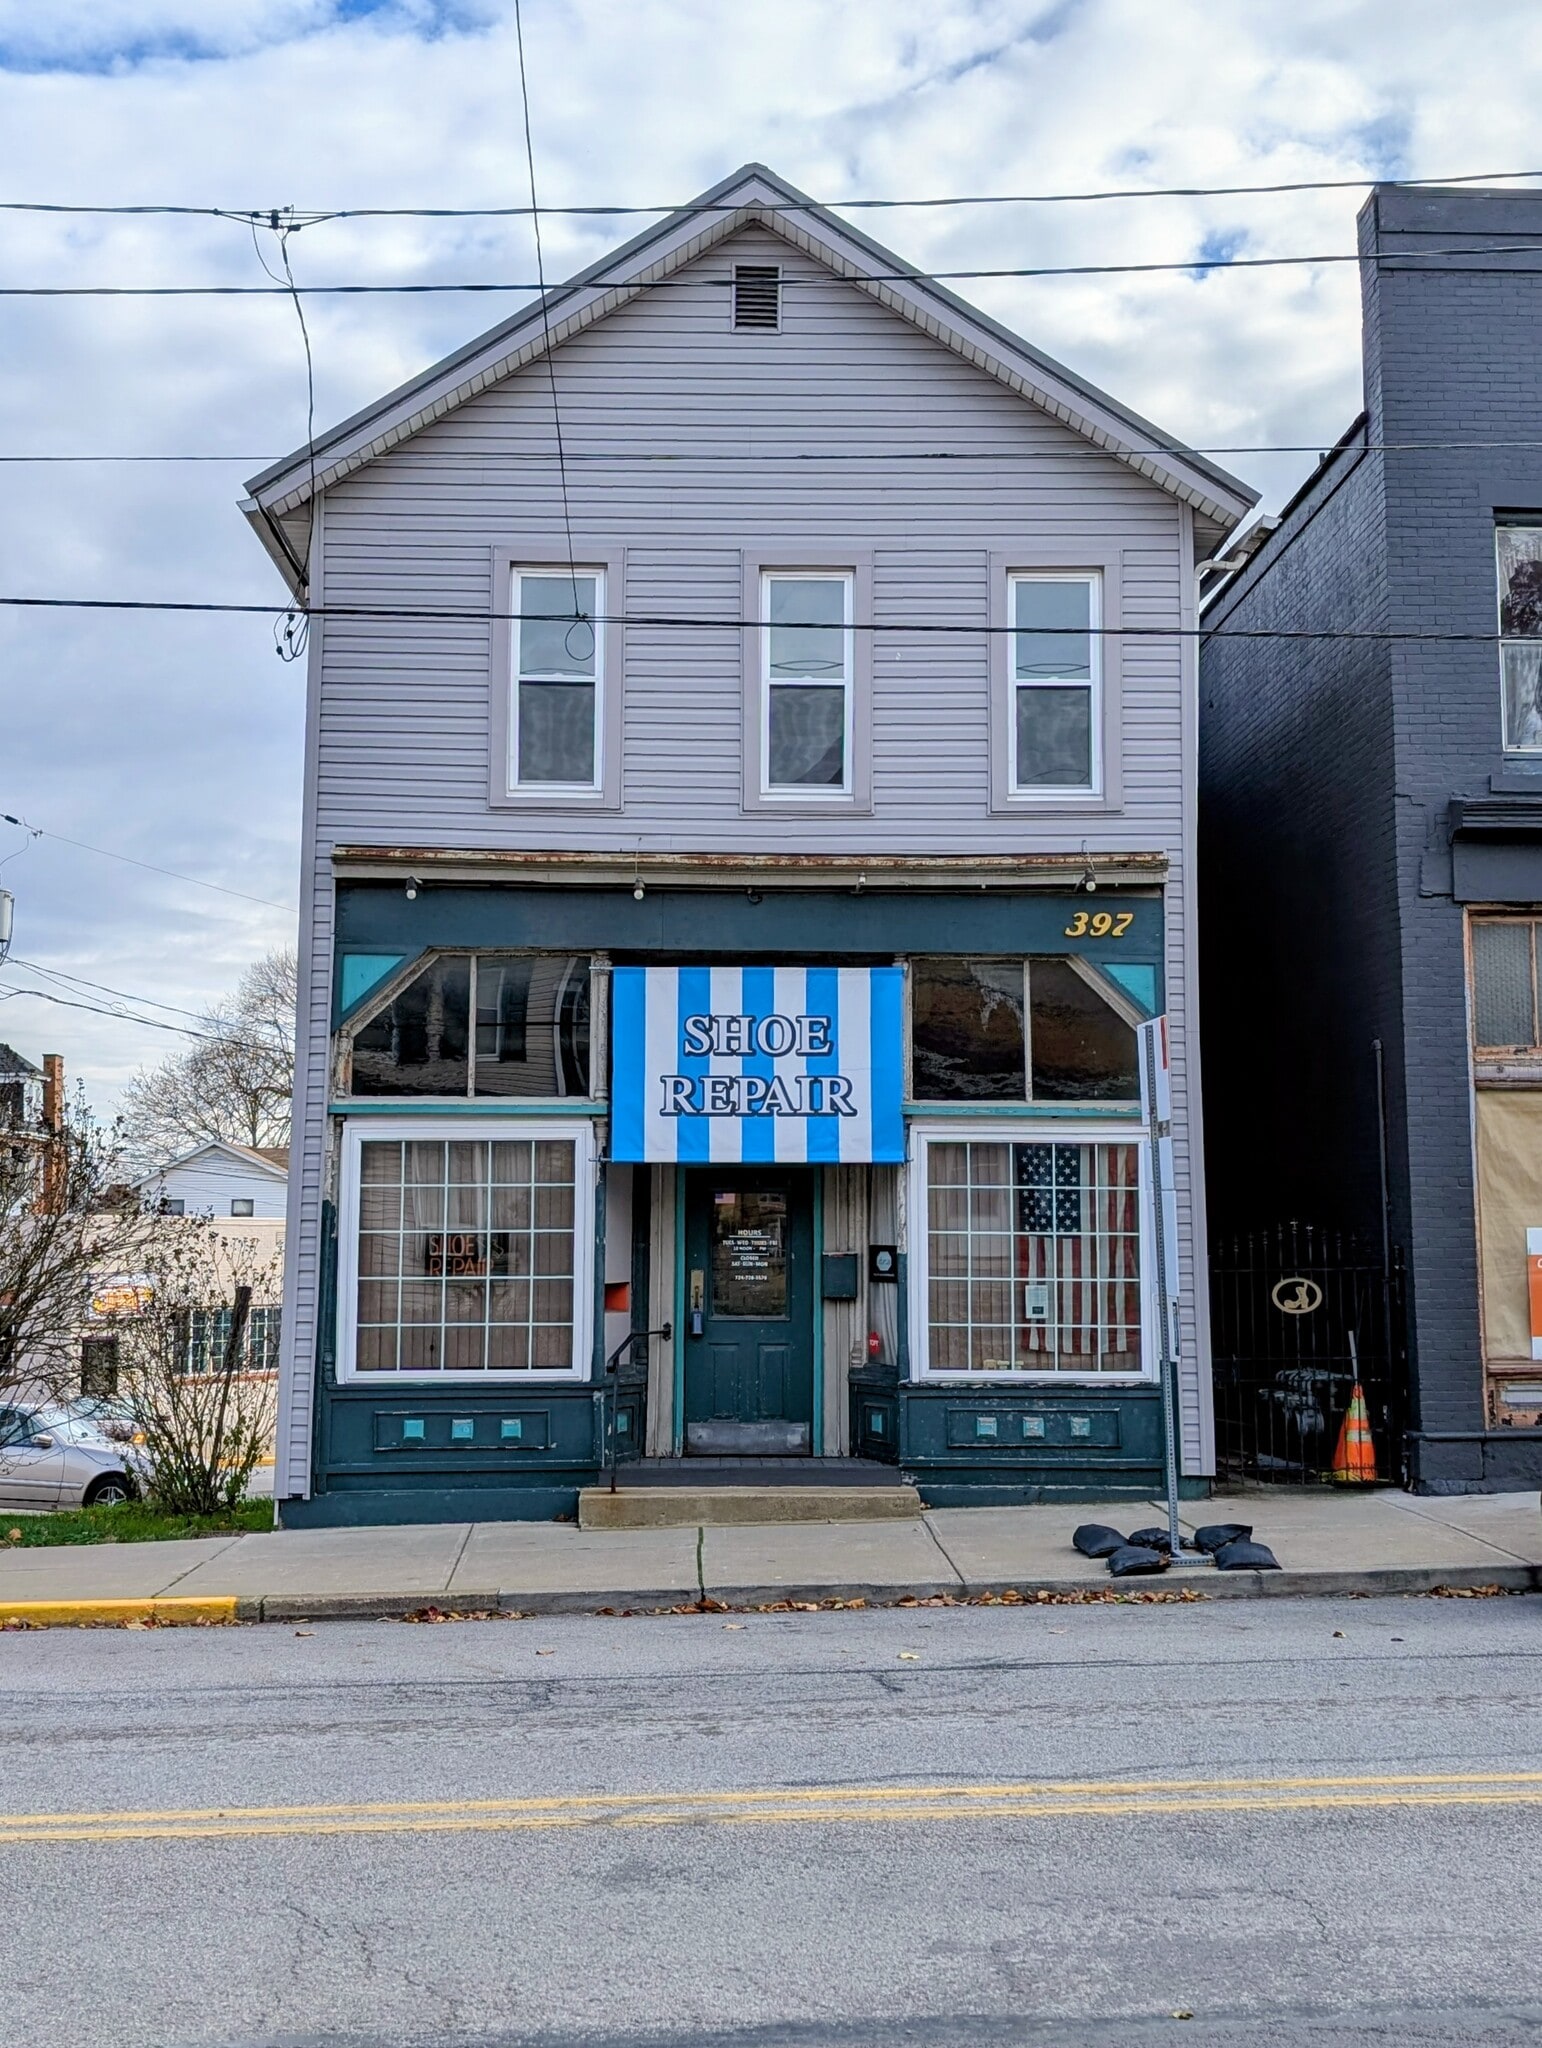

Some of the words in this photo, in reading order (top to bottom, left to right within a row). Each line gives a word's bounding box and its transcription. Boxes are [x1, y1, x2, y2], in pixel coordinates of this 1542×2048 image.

[1064, 911, 1134, 938] 397
[683, 1014, 834, 1058] SHOE
[660, 1075, 858, 1117] REPAIR
